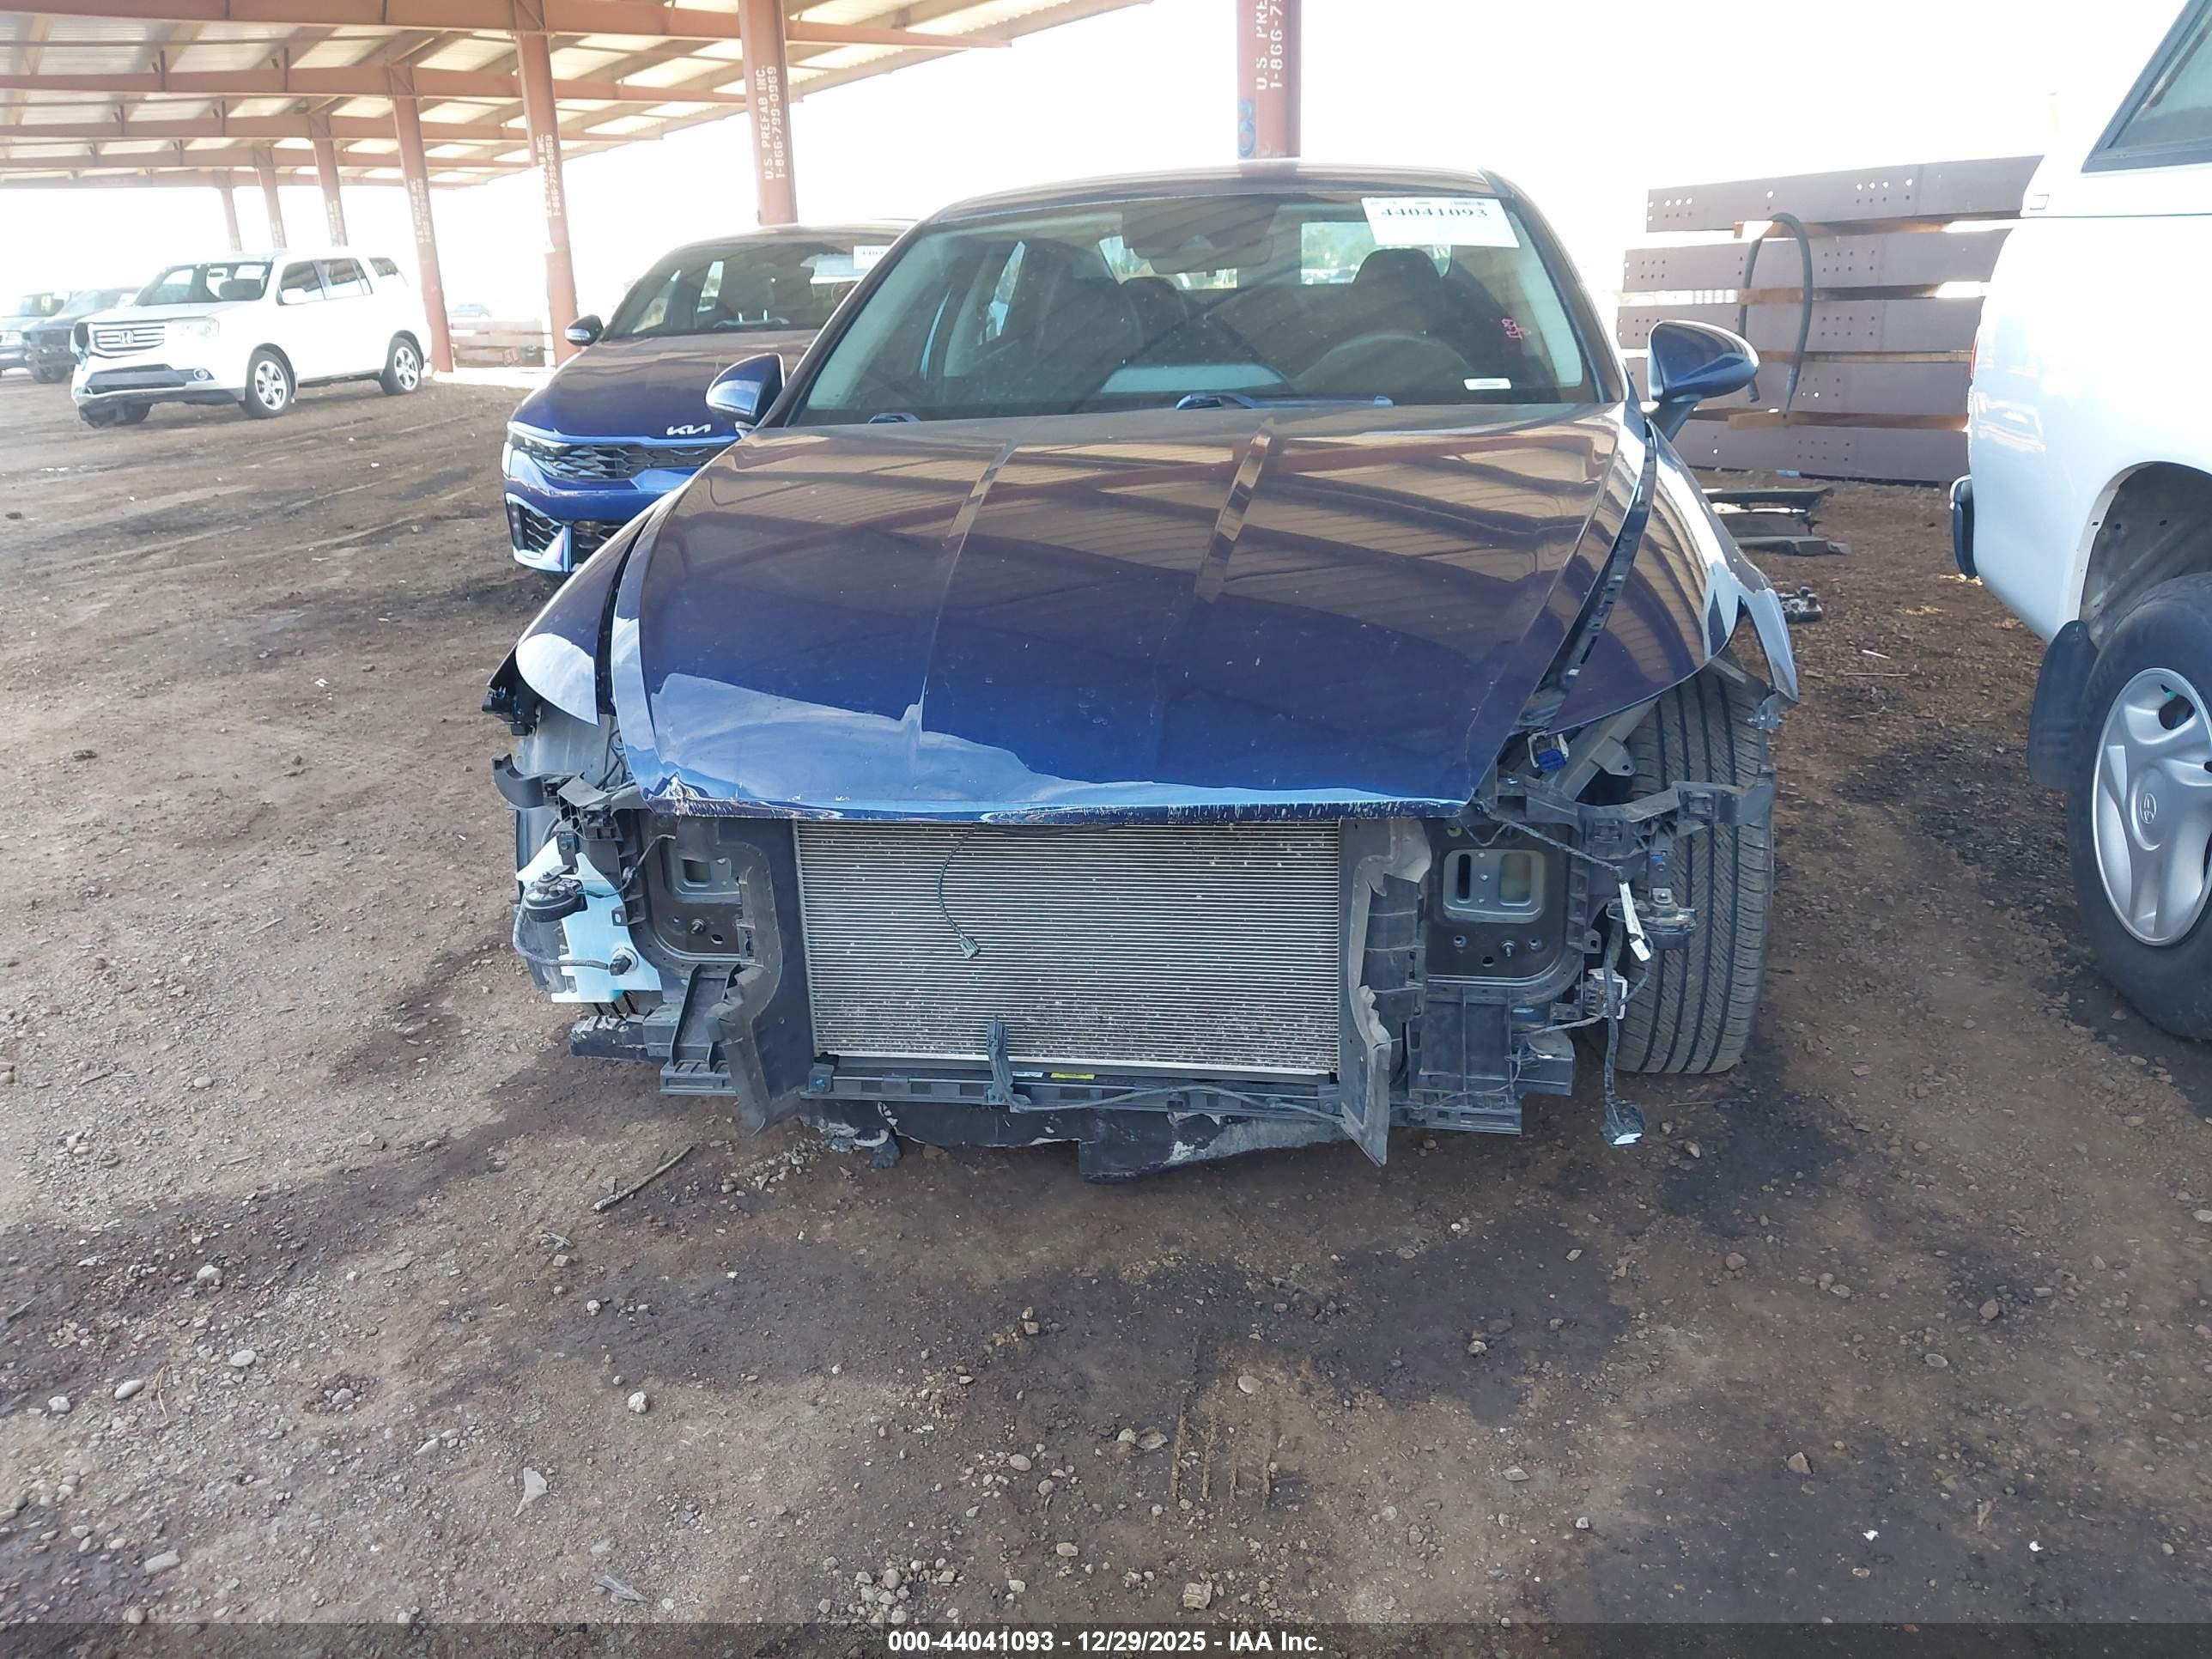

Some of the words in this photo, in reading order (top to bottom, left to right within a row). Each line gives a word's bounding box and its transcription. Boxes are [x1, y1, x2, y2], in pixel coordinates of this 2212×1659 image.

[1269, 0, 1283, 88] 1-866-7
[756, 65, 767, 90] INC.
[1256, 50, 1267, 90] U.S.
[758, 96, 771, 148] PREFAB
[763, 155, 774, 179] U.S.
[1382, 208, 1488, 218] 44041093
